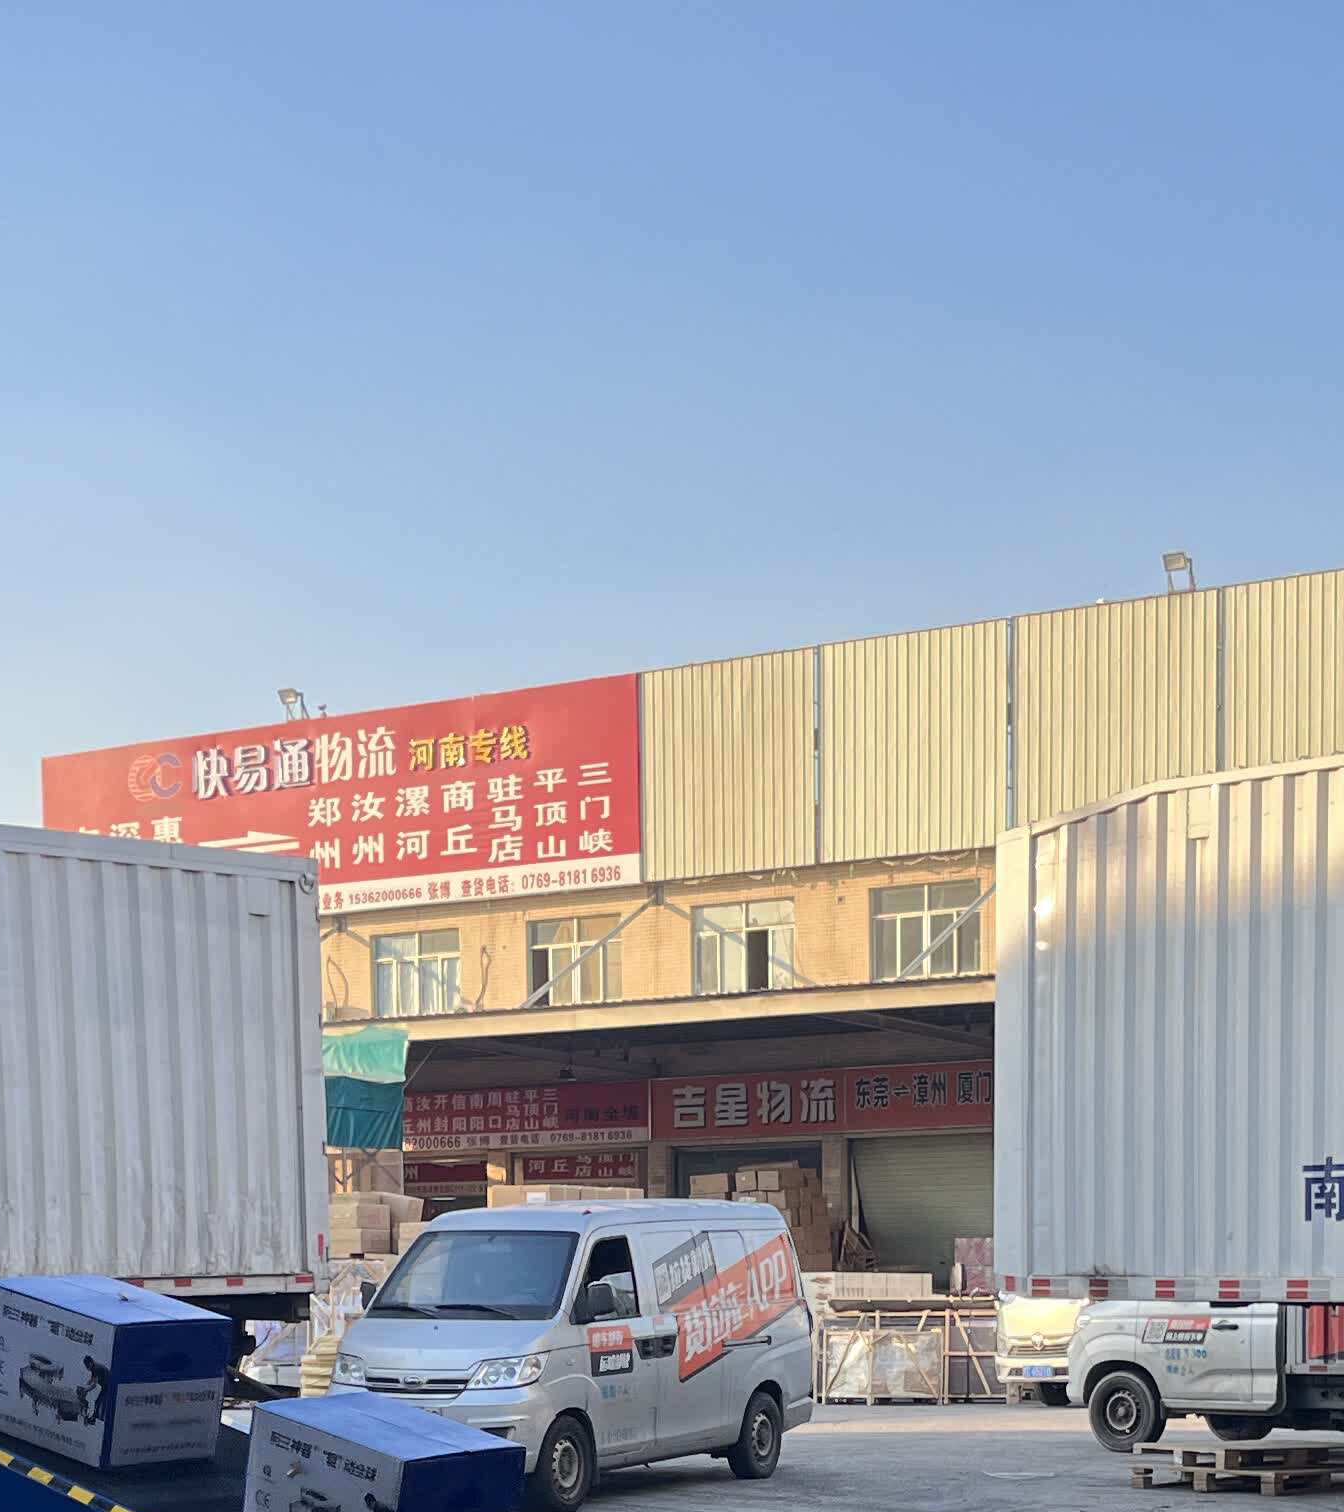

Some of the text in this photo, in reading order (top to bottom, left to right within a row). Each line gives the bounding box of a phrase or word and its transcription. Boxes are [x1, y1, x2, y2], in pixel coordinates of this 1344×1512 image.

[192, 725, 531, 800] 快易通物流 河南专线
[348, 887, 423, 905] 15362000666
[672, 1077, 838, 1129] 吉星物流
[855, 1072, 889, 1110] 东莞
[911, 1071, 947, 1109] 漳州
[745, 1249, 788, 1313] APP
